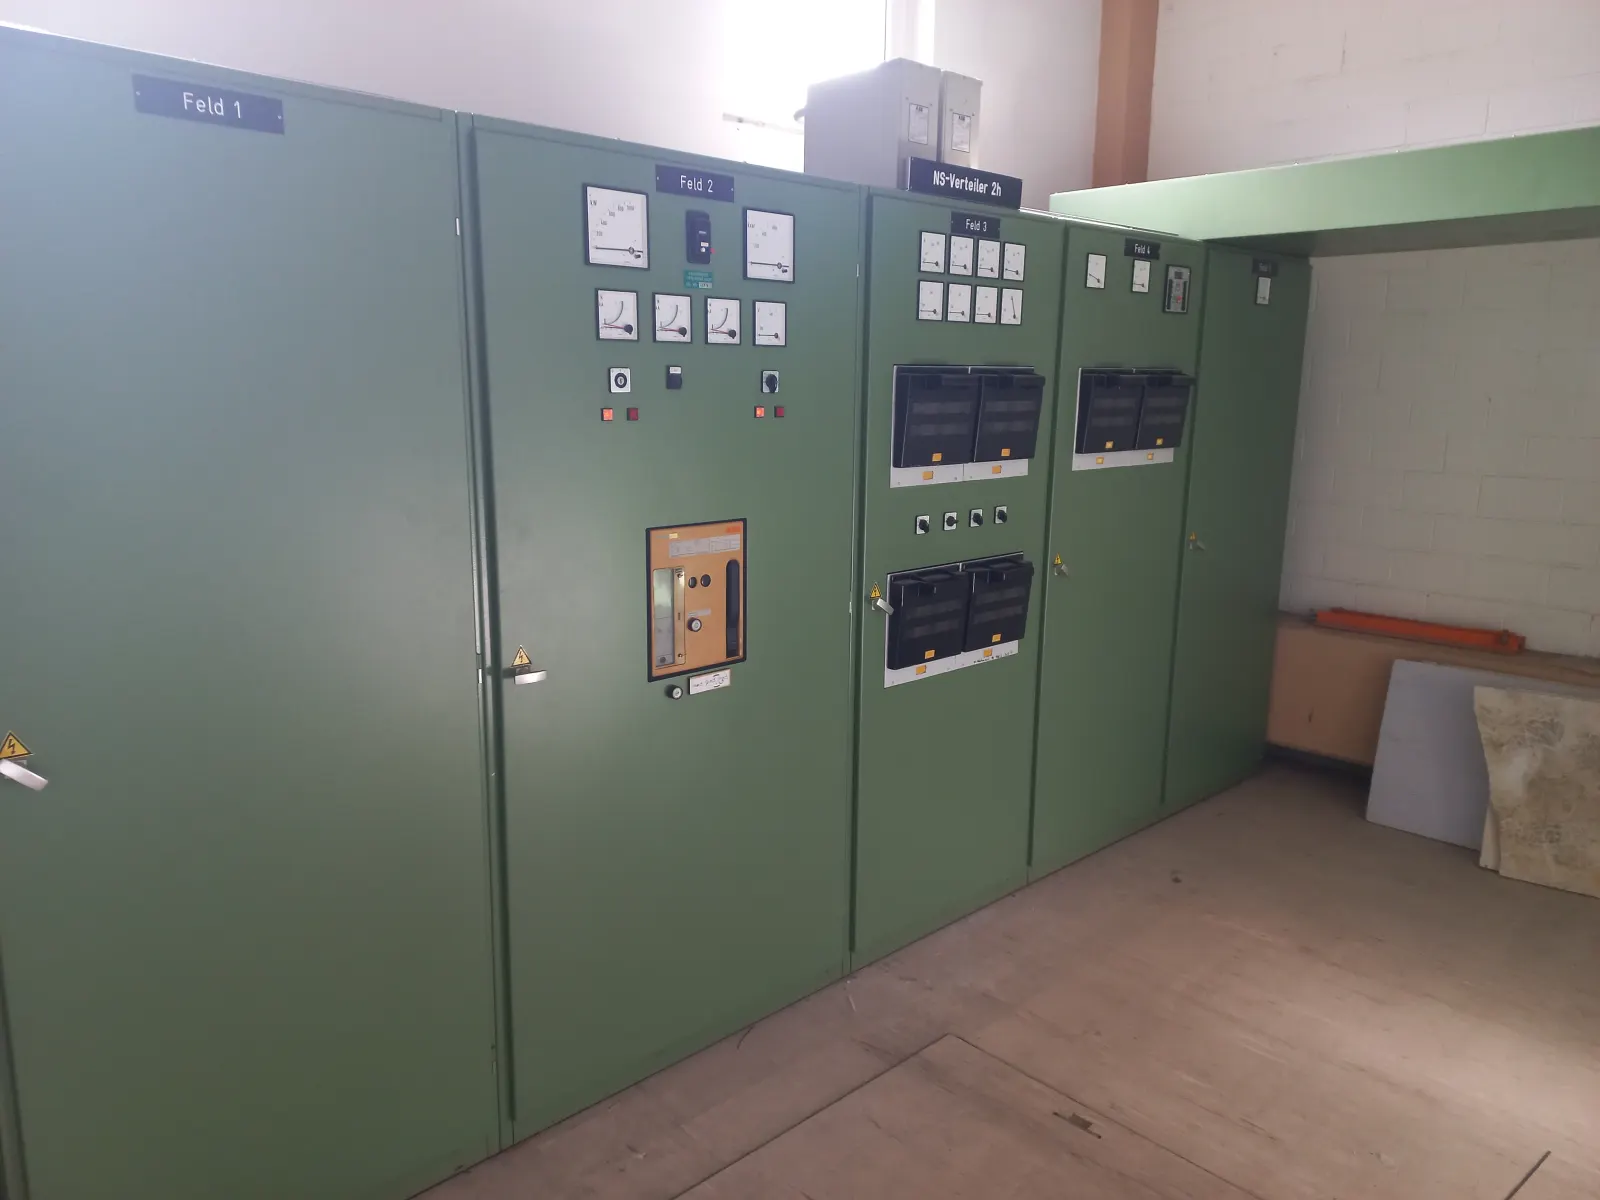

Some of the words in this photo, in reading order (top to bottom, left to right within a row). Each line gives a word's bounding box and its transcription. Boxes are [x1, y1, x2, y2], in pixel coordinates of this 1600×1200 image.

[183, 92, 224, 116] Feld
[234, 100, 241, 119] 1
[681, 175, 703, 191] Feld
[708, 180, 714, 193] 2
[933, 170, 989, 194] NS-Verteiler
[991, 181, 1003, 197] 2h
[965, 218, 980, 231] Feld
[983, 221, 988, 232] 3
[1134, 243, 1146, 254] Feld
